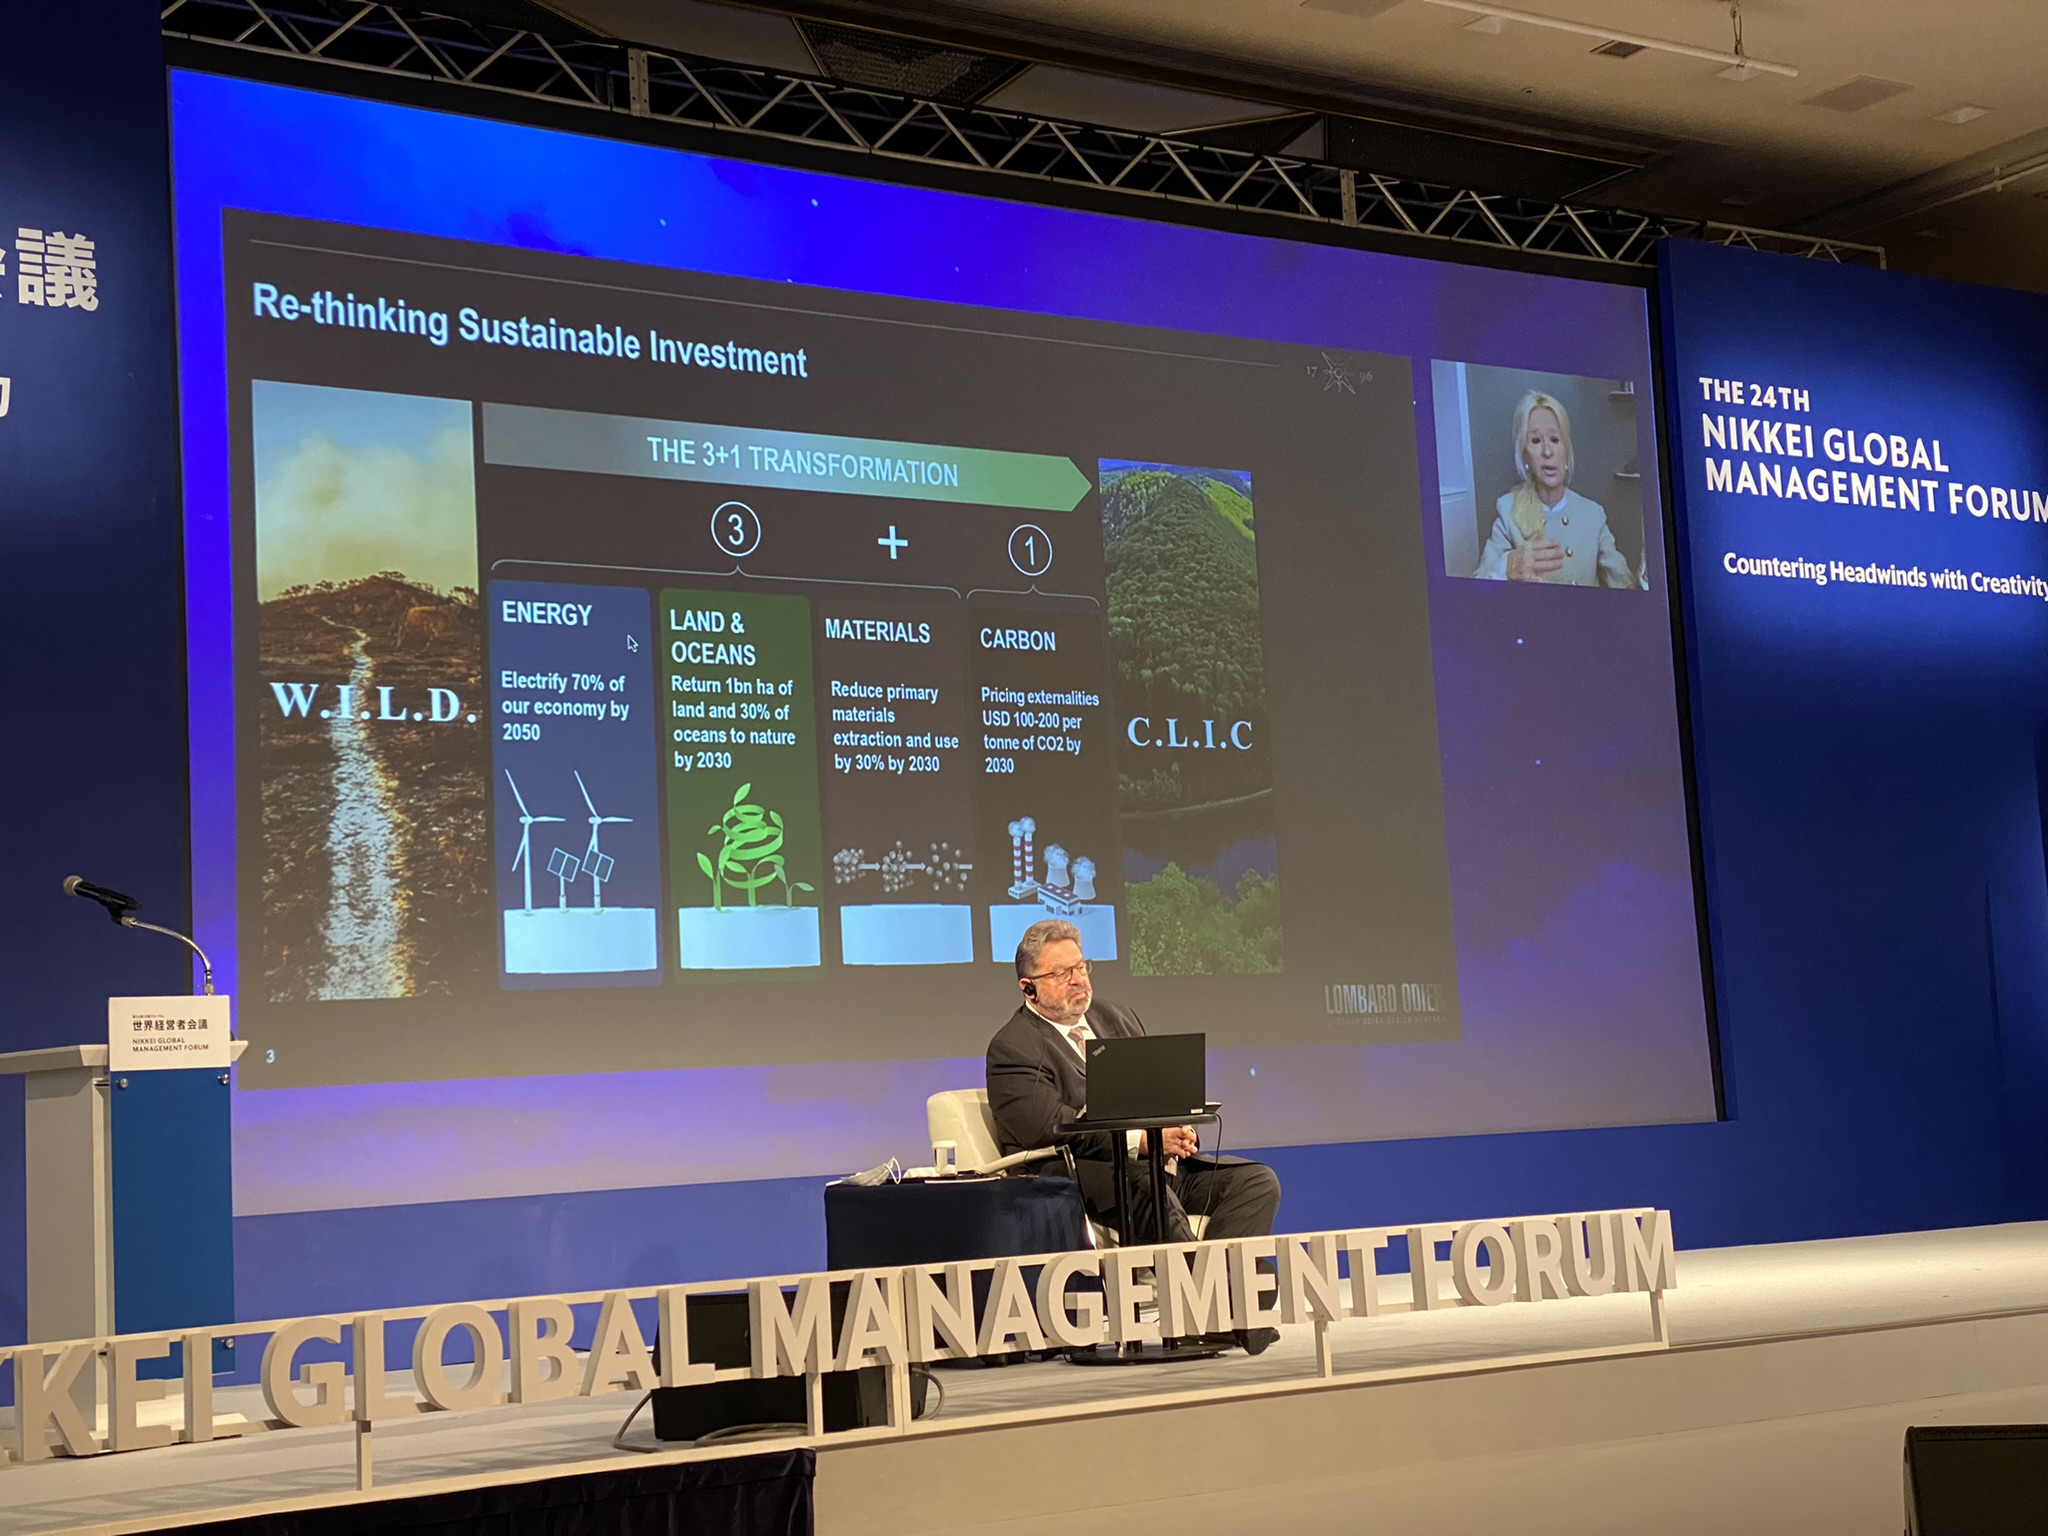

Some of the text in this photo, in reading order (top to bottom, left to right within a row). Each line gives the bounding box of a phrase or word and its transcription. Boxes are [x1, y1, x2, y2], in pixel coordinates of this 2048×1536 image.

[0, 227, 99, 312] 議
[252, 281, 808, 378] Re-thinking Sustainable Investment
[1699, 377, 1810, 412] THE 24TH
[1702, 413, 1949, 473] NIKKEI GLOBAL
[647, 436, 959, 487] THE 3+1 TRANSFORMATION
[1705, 457, 1939, 513] MANAGEMENT
[728, 513, 744, 546] 3
[1723, 552, 1827, 586] Countering
[1829, 560, 1928, 588] Headwinds
[1930, 568, 1968, 591] with
[502, 600, 593, 627] ENERGY
[670, 609, 745, 634] LAND &
[825, 618, 931, 644] MATERIALS
[980, 628, 1056, 651] CARBON
[671, 641, 756, 666] OCEANS
[501, 671, 625, 693] Electrify 70% of
[671, 675, 793, 696] Return 1bn ha of
[831, 681, 939, 704] Reduce primary
[270, 682, 478, 724] W.I.L.D.
[981, 687, 1099, 707] Pricing externalities
[502, 699, 629, 721] our economy by
[672, 701, 790, 721] land and 30% of
[832, 707, 896, 723] materials
[982, 710, 1082, 732] USD 100-200 per
[502, 723, 541, 741] 2050
[673, 727, 796, 746] oceans to nature
[833, 730, 959, 749] extraction and use
[1127, 716, 1253, 750] C.L.I.C
[984, 734, 1081, 755] tonne of CO2 by
[674, 751, 732, 772] by 2030
[834, 753, 940, 775] by 30% by 2030
[985, 757, 1014, 773] 2030
[1324, 983, 1397, 1014] LOMBARD
[132, 1019, 208, 1031] 世界経営者会議
[265, 1048, 276, 1064] 3
[0, 1208, 1678, 1465] KEI GLOBAL MANAGEMENT FORUM
